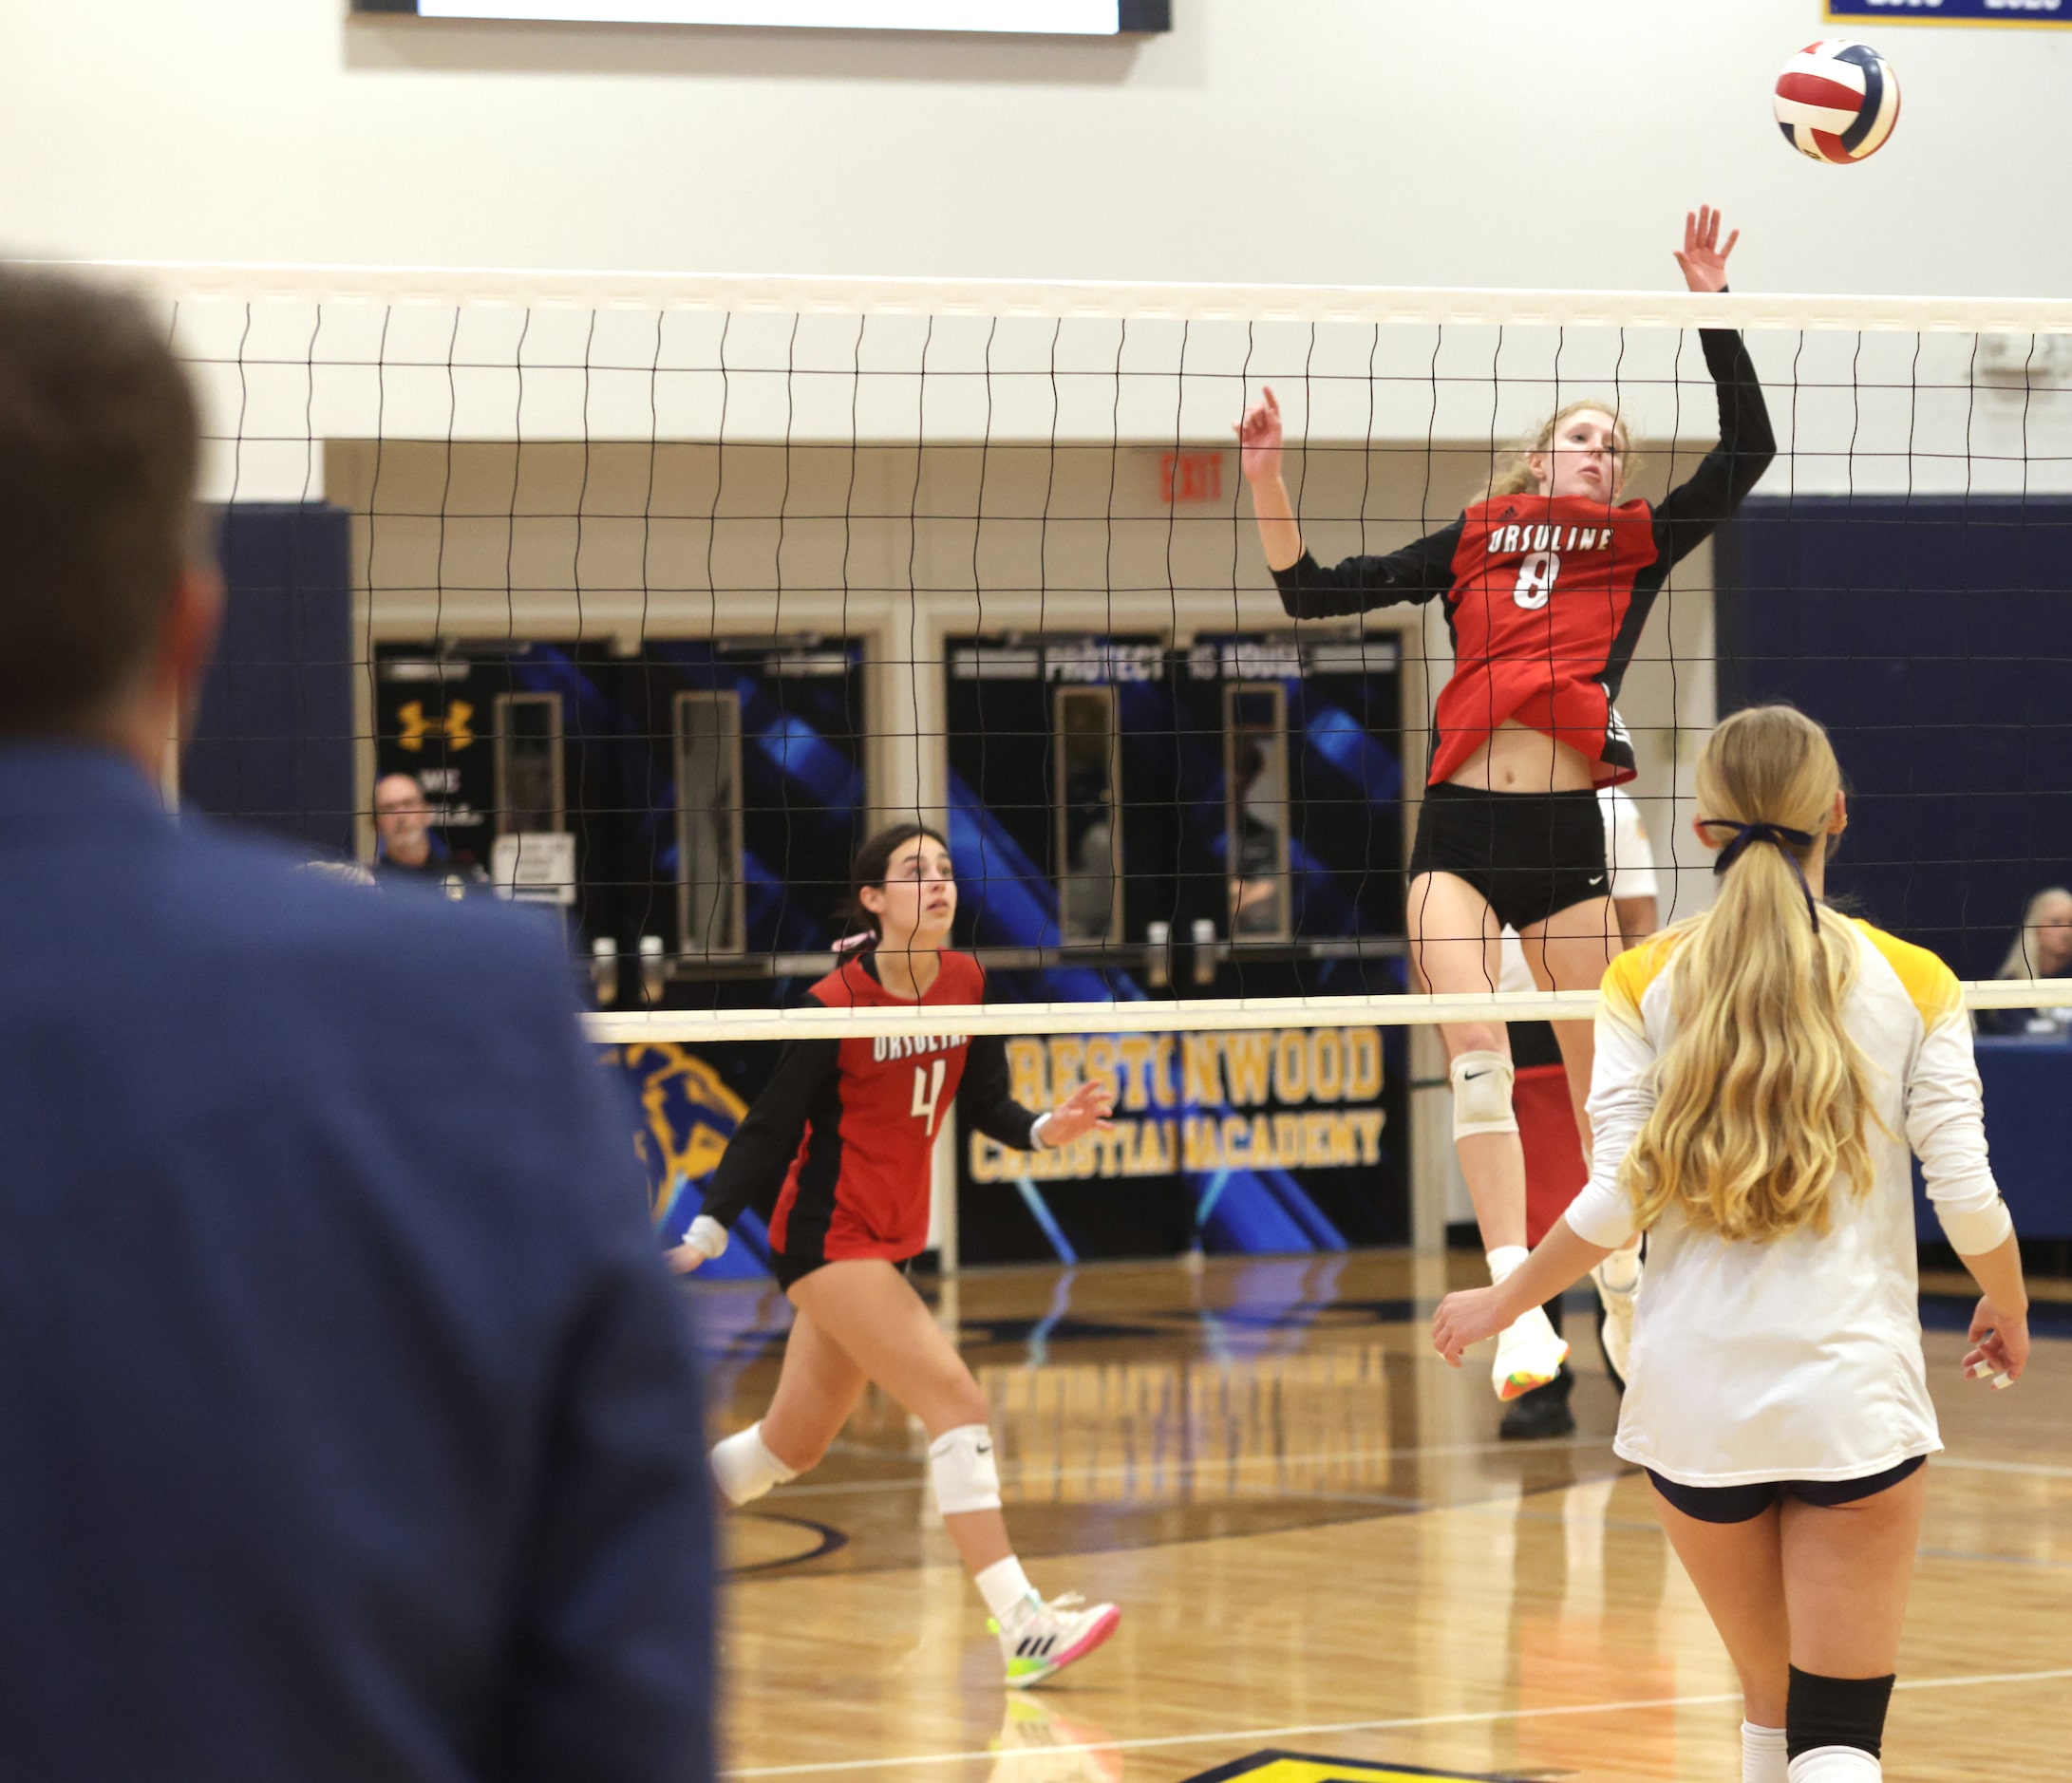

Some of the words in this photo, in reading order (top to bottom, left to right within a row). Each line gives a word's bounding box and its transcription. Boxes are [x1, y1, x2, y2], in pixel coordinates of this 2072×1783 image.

[1161, 453, 1222, 502] EXIT
[1488, 524, 1612, 553] URSULINE
[1513, 552, 1560, 610] 8
[911, 1059, 946, 1137] 4
[1005, 1027, 1383, 1114] RESTONWOOD
